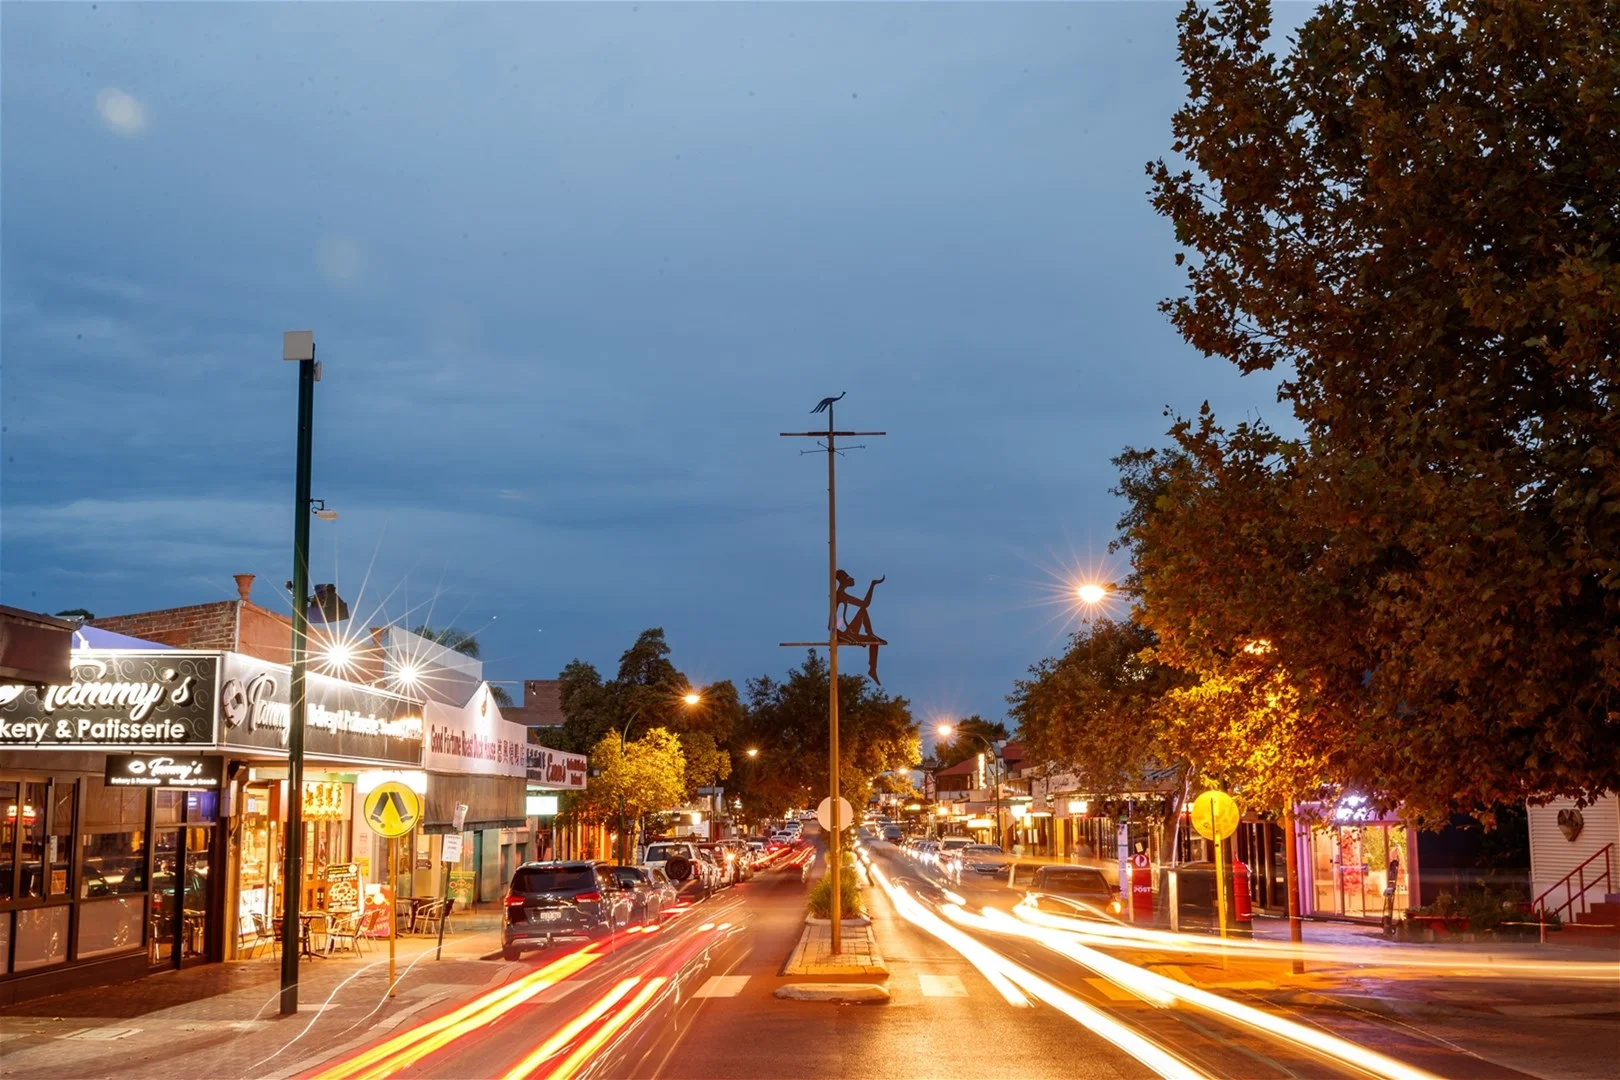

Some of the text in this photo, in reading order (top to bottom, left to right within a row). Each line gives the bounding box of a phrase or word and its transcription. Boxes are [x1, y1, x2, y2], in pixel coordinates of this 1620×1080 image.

[42, 657, 195, 721] Tammy's
[55, 720, 72, 738] &
[77, 718, 186, 738] Patisserie
[431, 724, 443, 753] Good
[444, 727, 461, 755] Fortune
[147, 757, 203, 780] Tammy's
